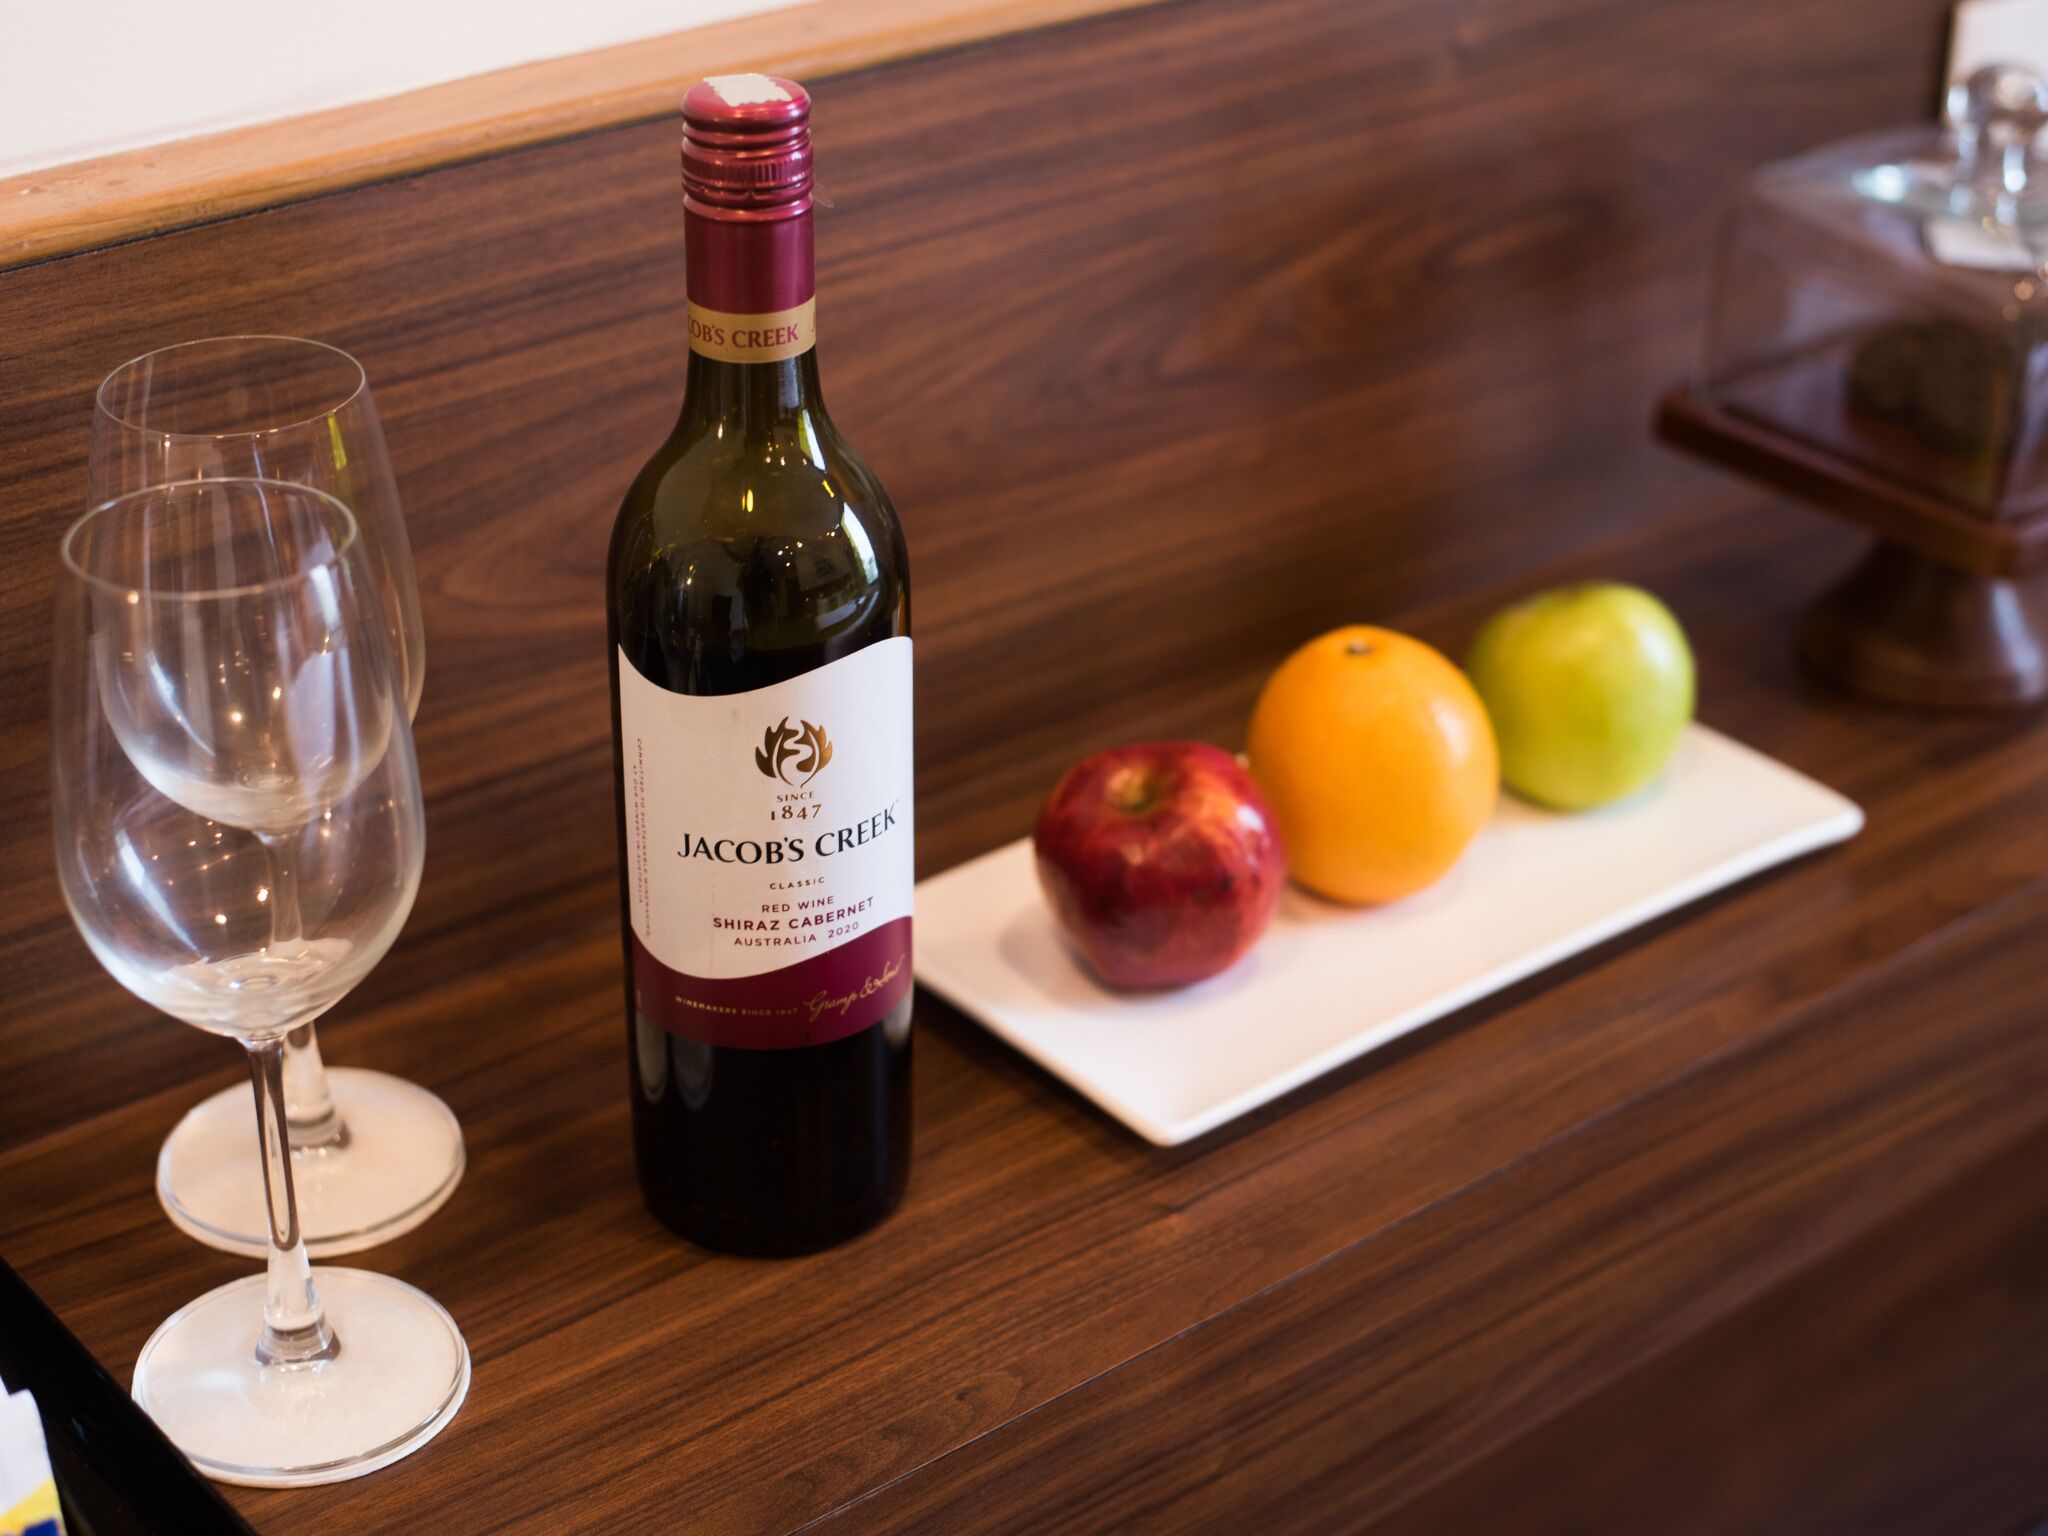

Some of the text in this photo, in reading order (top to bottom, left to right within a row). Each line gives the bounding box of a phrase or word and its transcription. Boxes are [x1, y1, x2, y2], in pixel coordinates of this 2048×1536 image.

[731, 323, 799, 349] CREEK
[776, 791, 816, 803] SINCE
[770, 804, 822, 821] 1847
[677, 802, 897, 865] JACOB'S CREEK
[769, 876, 826, 890] CLASSIC
[713, 896, 875, 931] SHIRAZ CABERNET
[762, 896, 835, 913] RED WINE
[734, 922, 860, 947] AUSTRALIA 2020
